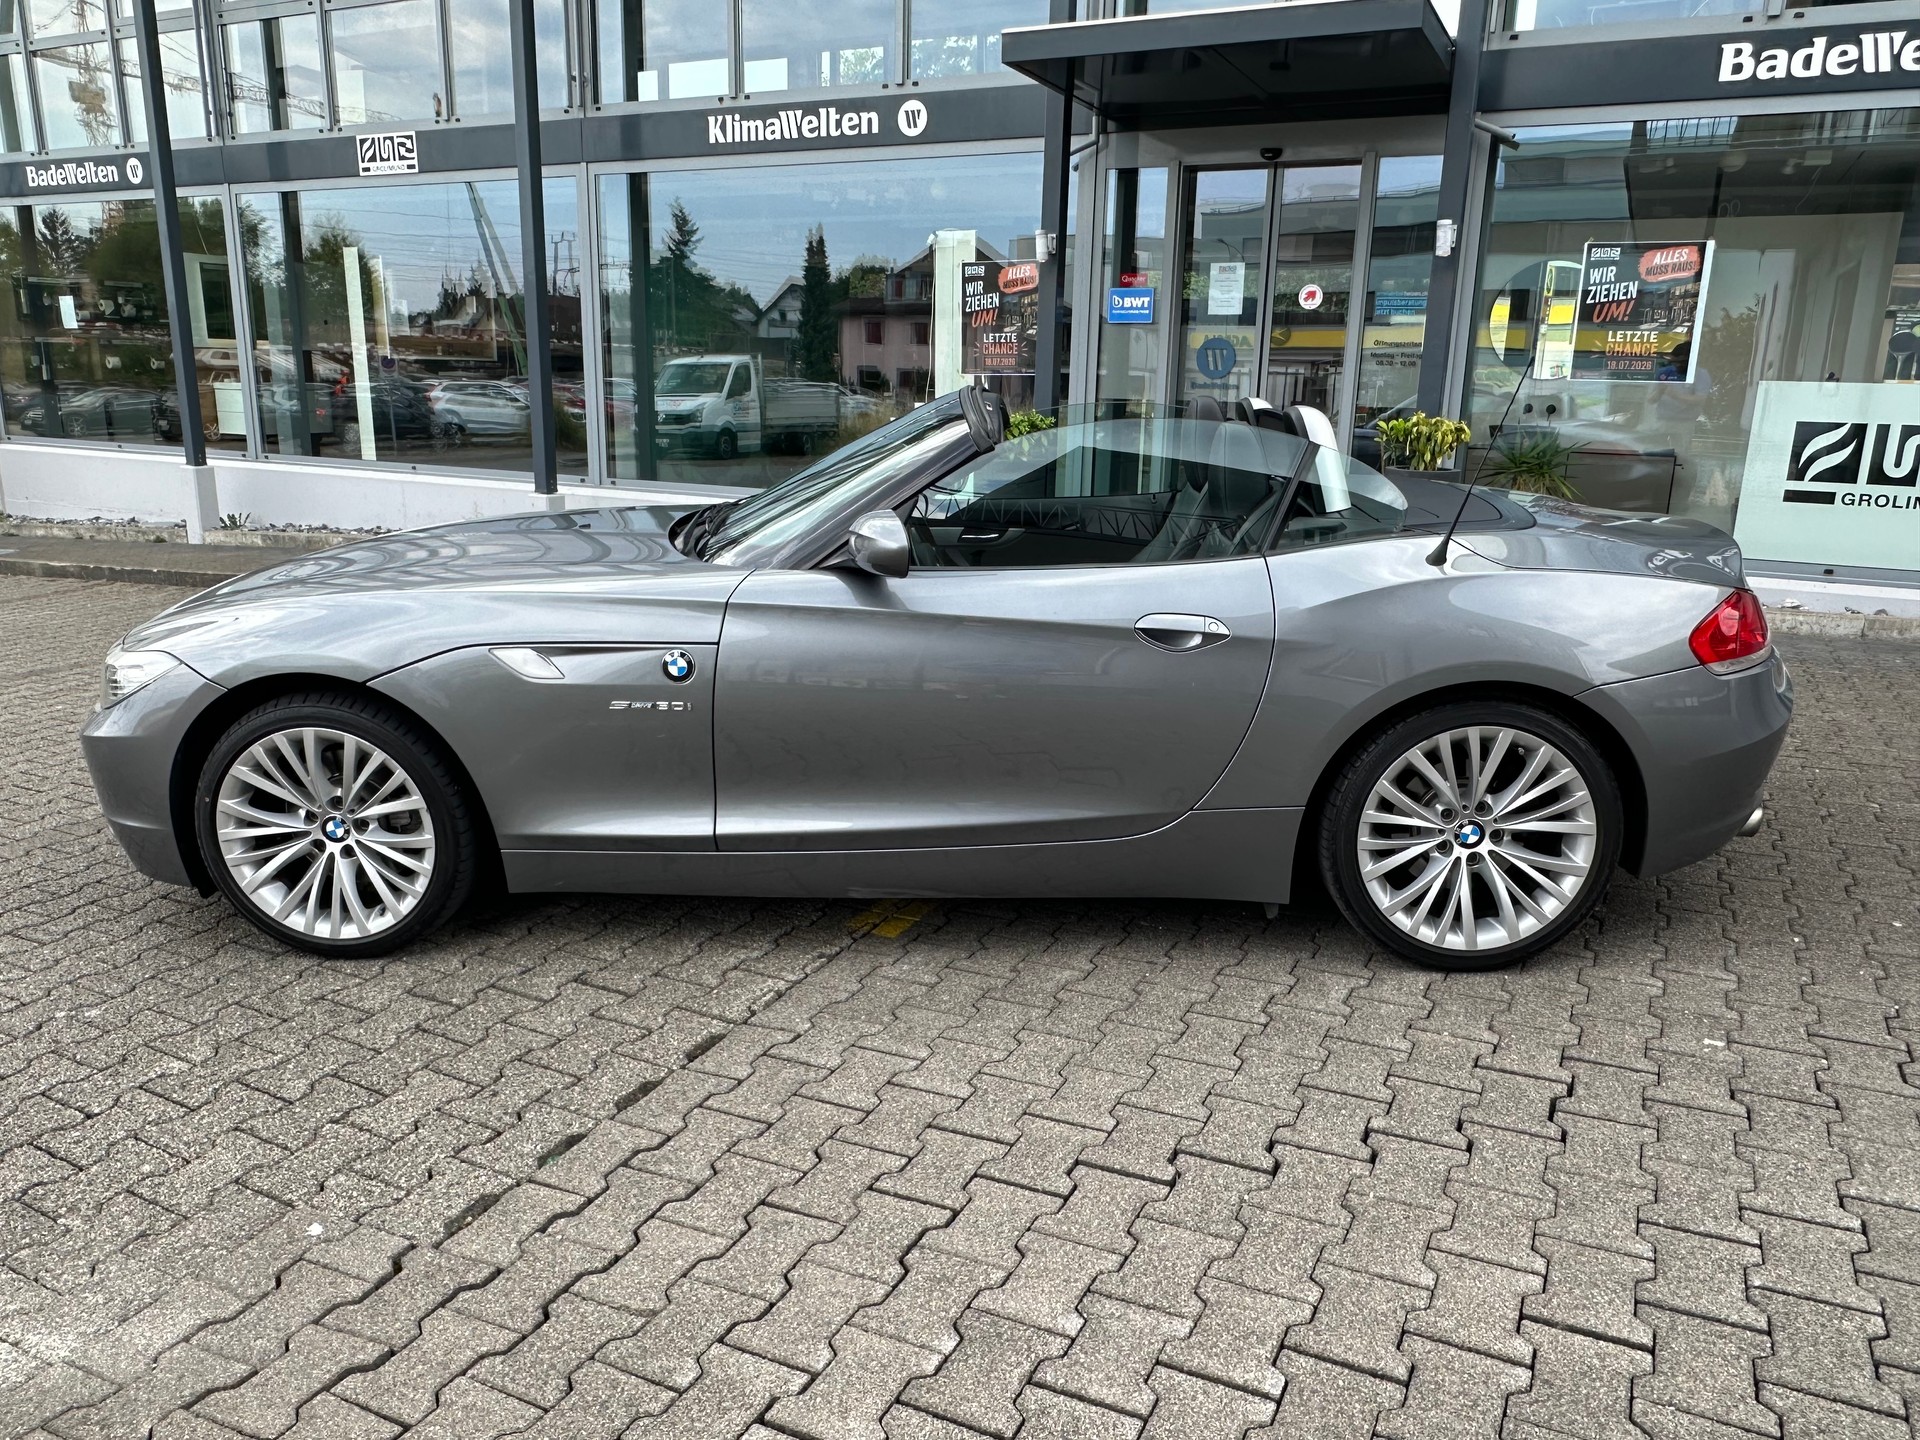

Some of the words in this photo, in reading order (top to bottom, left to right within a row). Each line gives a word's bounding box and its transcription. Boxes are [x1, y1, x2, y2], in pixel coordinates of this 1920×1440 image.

[707, 107, 879, 144] KlimaWelten
[25, 162, 119, 187] BadeWelten
[1653, 249, 1688, 265] ALLES
[1007, 266, 1030, 280] ALLES
[1590, 266, 1617, 285] WIR
[1645, 263, 1669, 277] MUSS
[1671, 261, 1696, 274] RAUS!
[965, 281, 984, 296] WIR
[1586, 281, 1639, 304] ZIEHEN
[965, 292, 1000, 312] ZIEHEN
[1123, 297, 1151, 307] BWT
[971, 309, 998, 328] UM!
[1592, 300, 1635, 323] UM!
[983, 333, 1018, 342] LETZTE
[1607, 331, 1659, 342] LETZTE
[982, 343, 1018, 354] CHANCE
[1605, 343, 1659, 356] CHANCE
